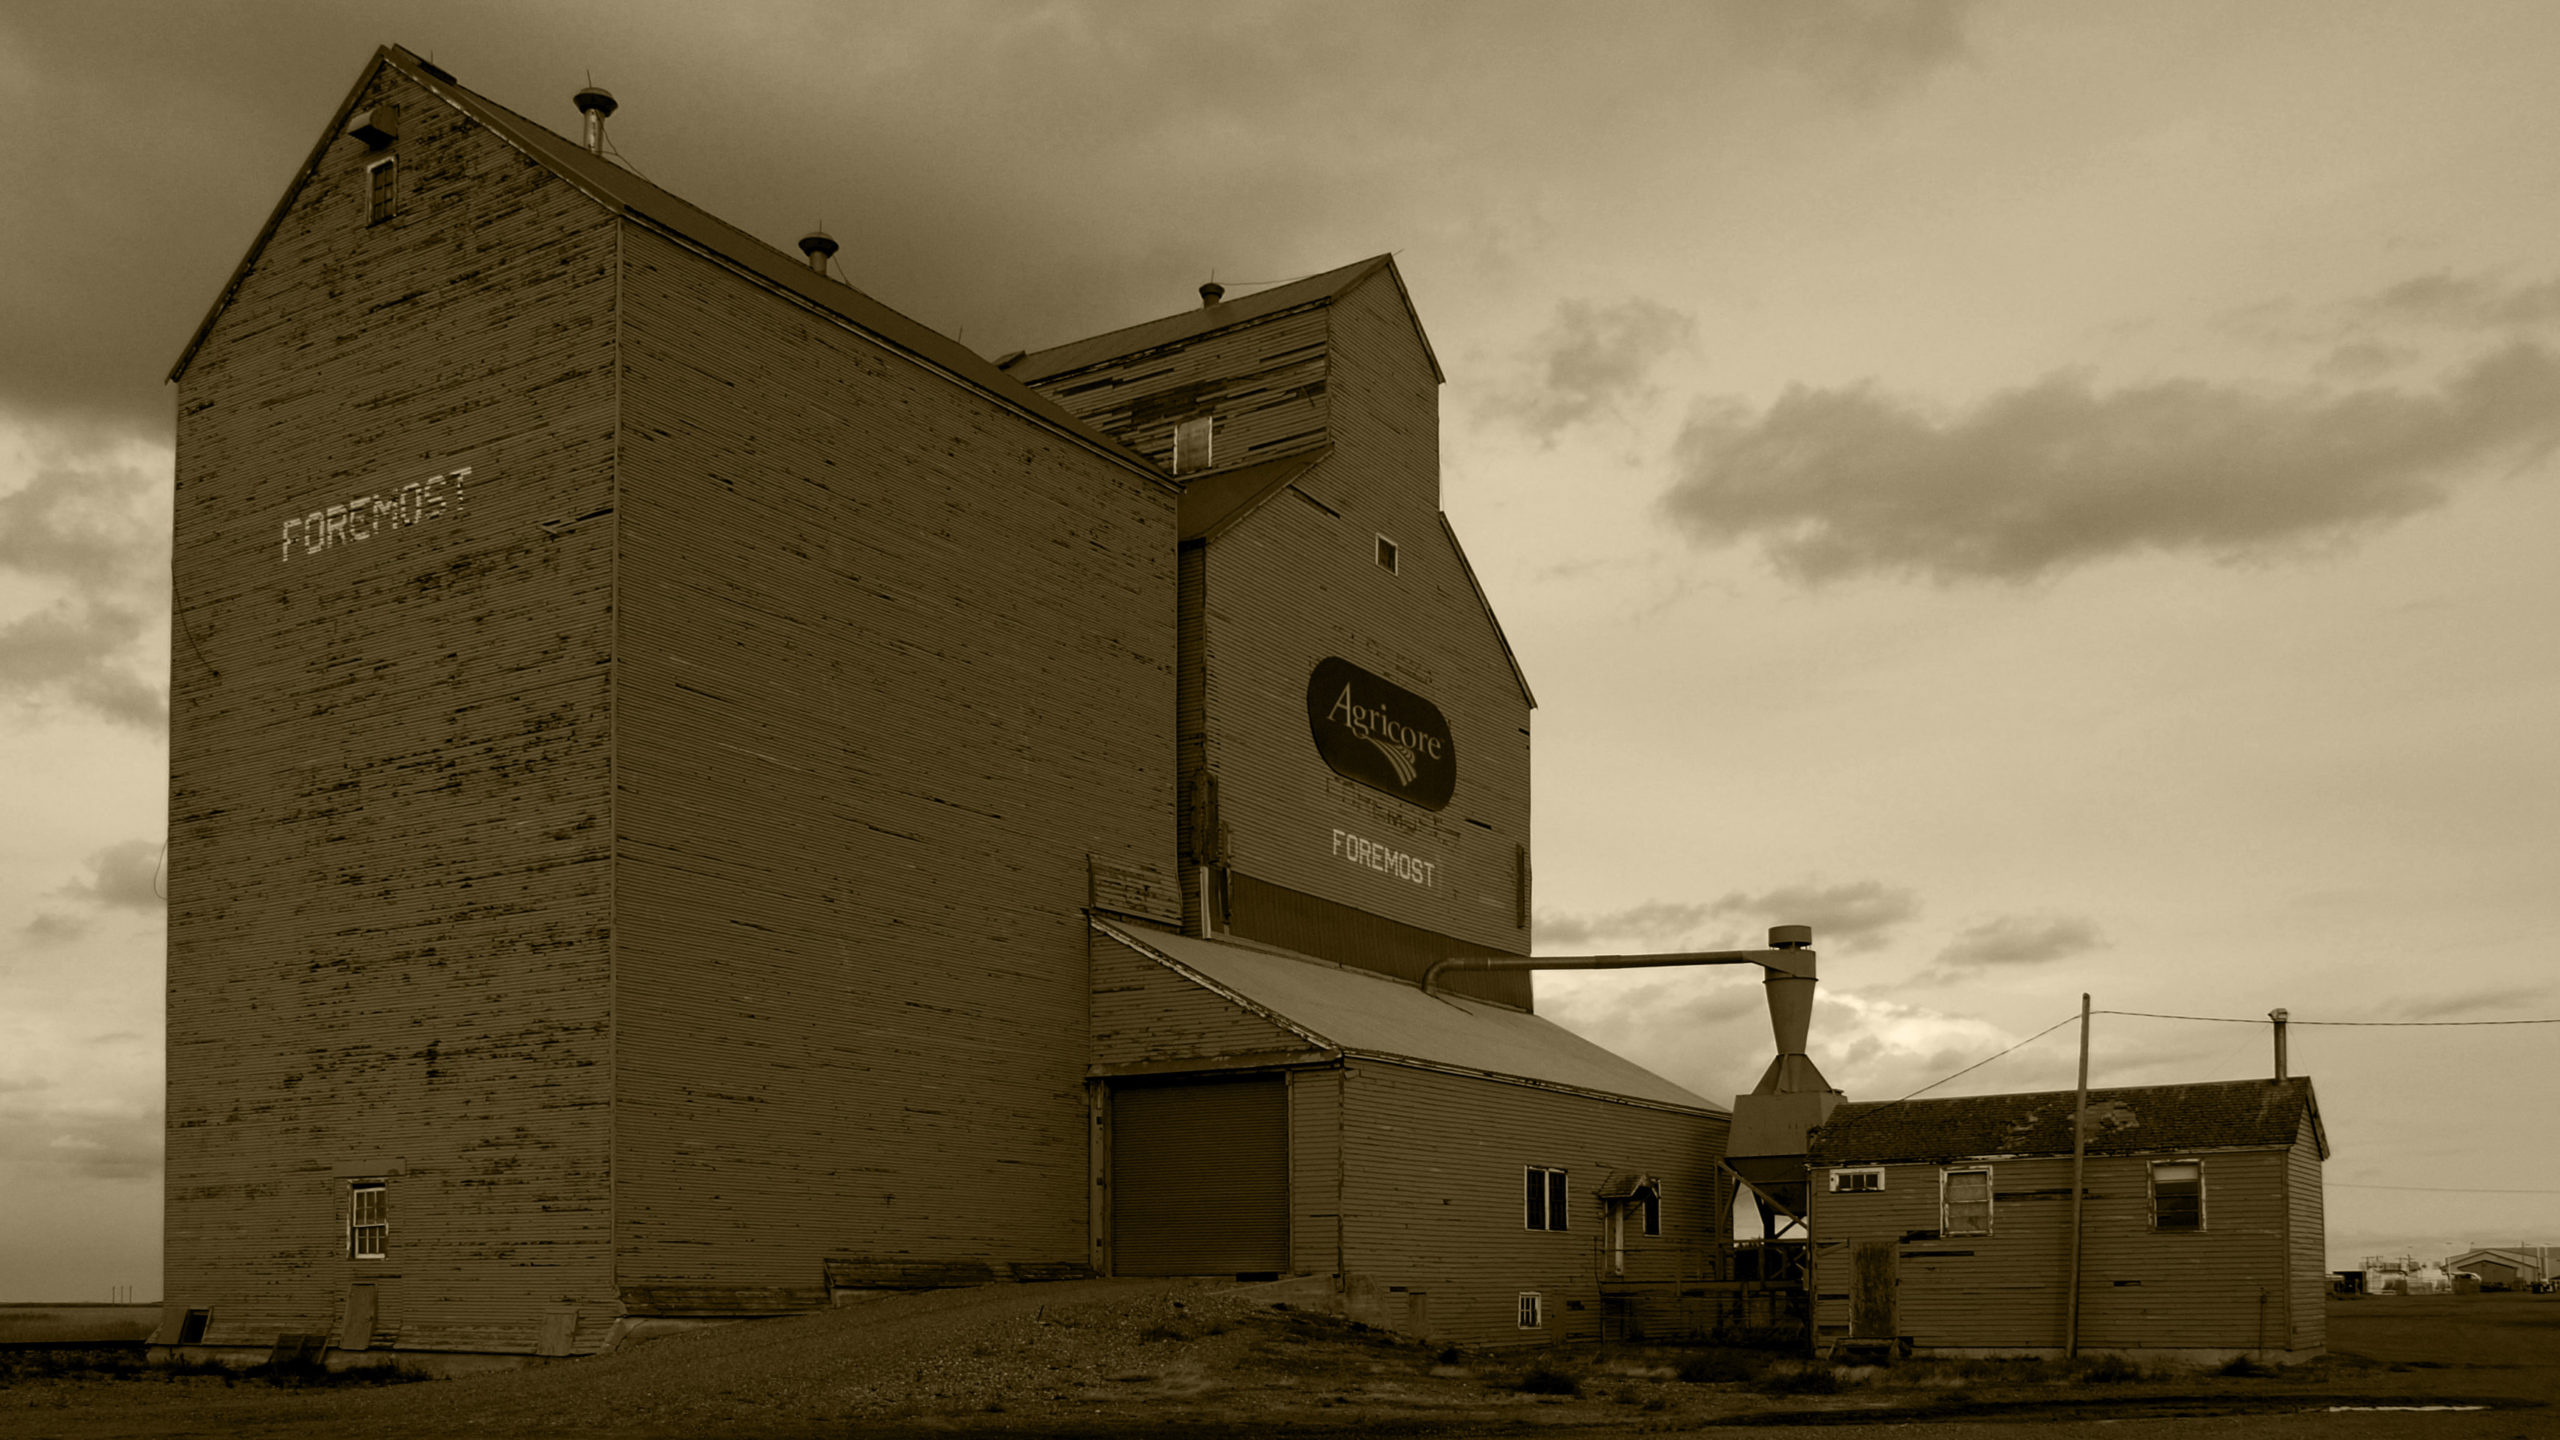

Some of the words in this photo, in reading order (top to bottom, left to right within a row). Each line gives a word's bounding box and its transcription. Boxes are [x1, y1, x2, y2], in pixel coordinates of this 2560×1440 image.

[282, 466, 472, 562] FOREMOST
[1327, 681, 1442, 760] Agricore
[1332, 828, 1435, 887] FOREMOST
